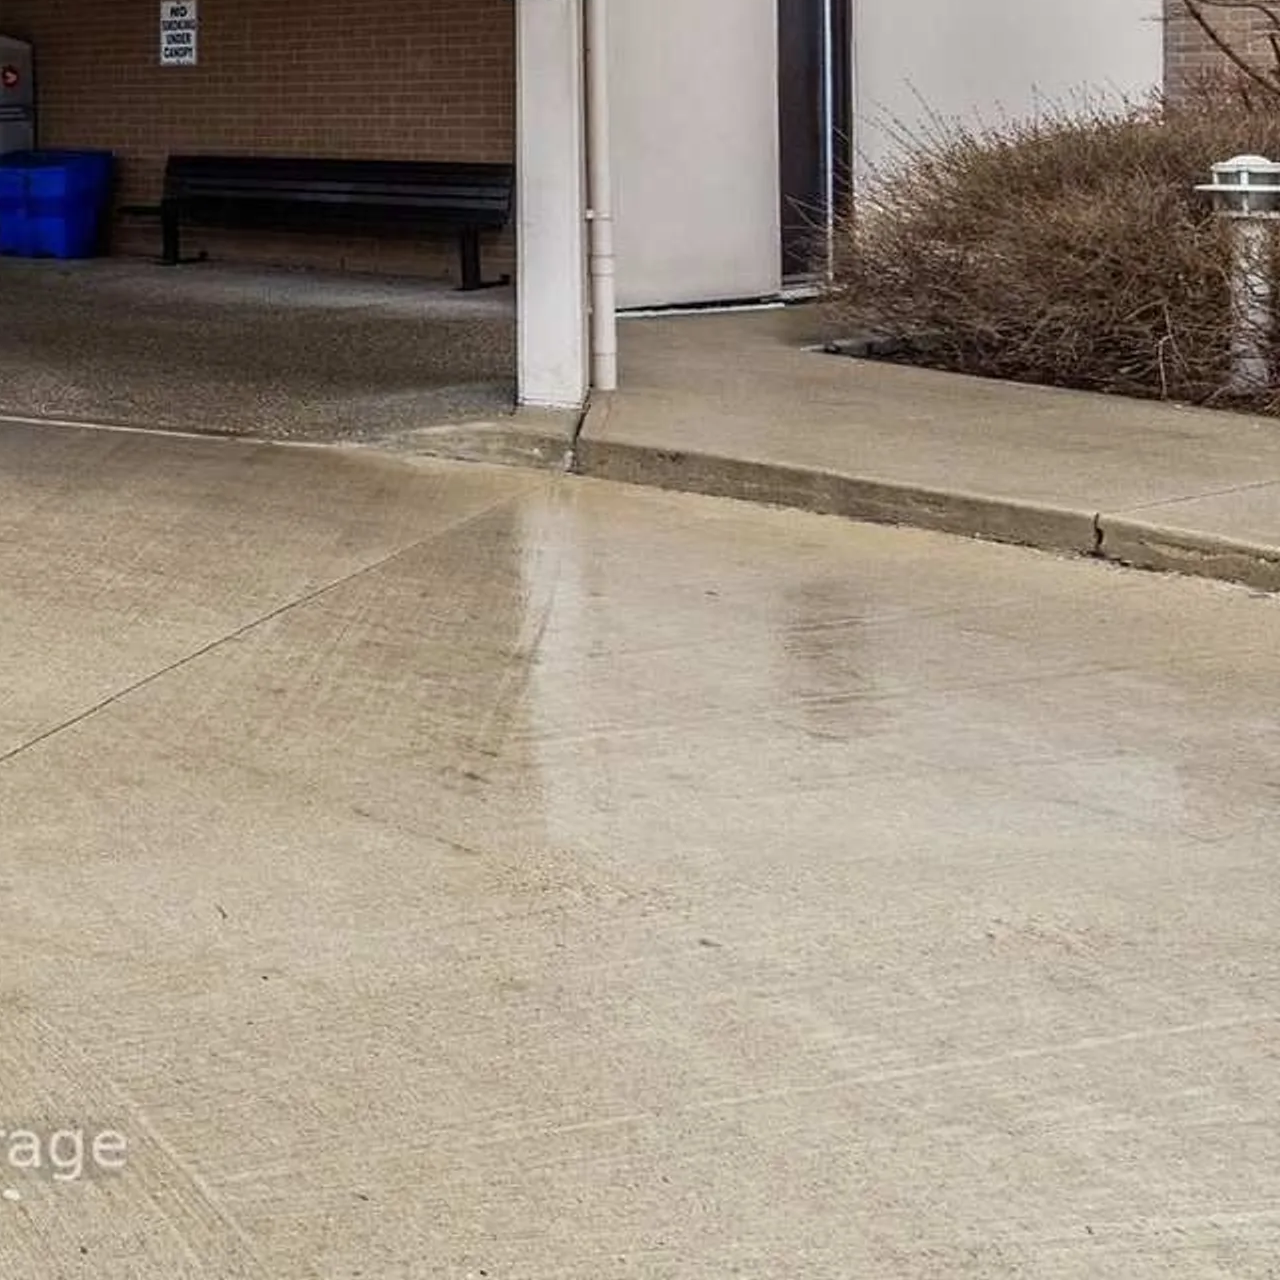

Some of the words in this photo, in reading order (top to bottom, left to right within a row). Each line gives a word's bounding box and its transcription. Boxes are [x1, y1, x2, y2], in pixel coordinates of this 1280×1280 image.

[171, 6, 187, 17] NO
[166, 33, 192, 45] UNDER
[164, 46, 193, 58] CANOPY
